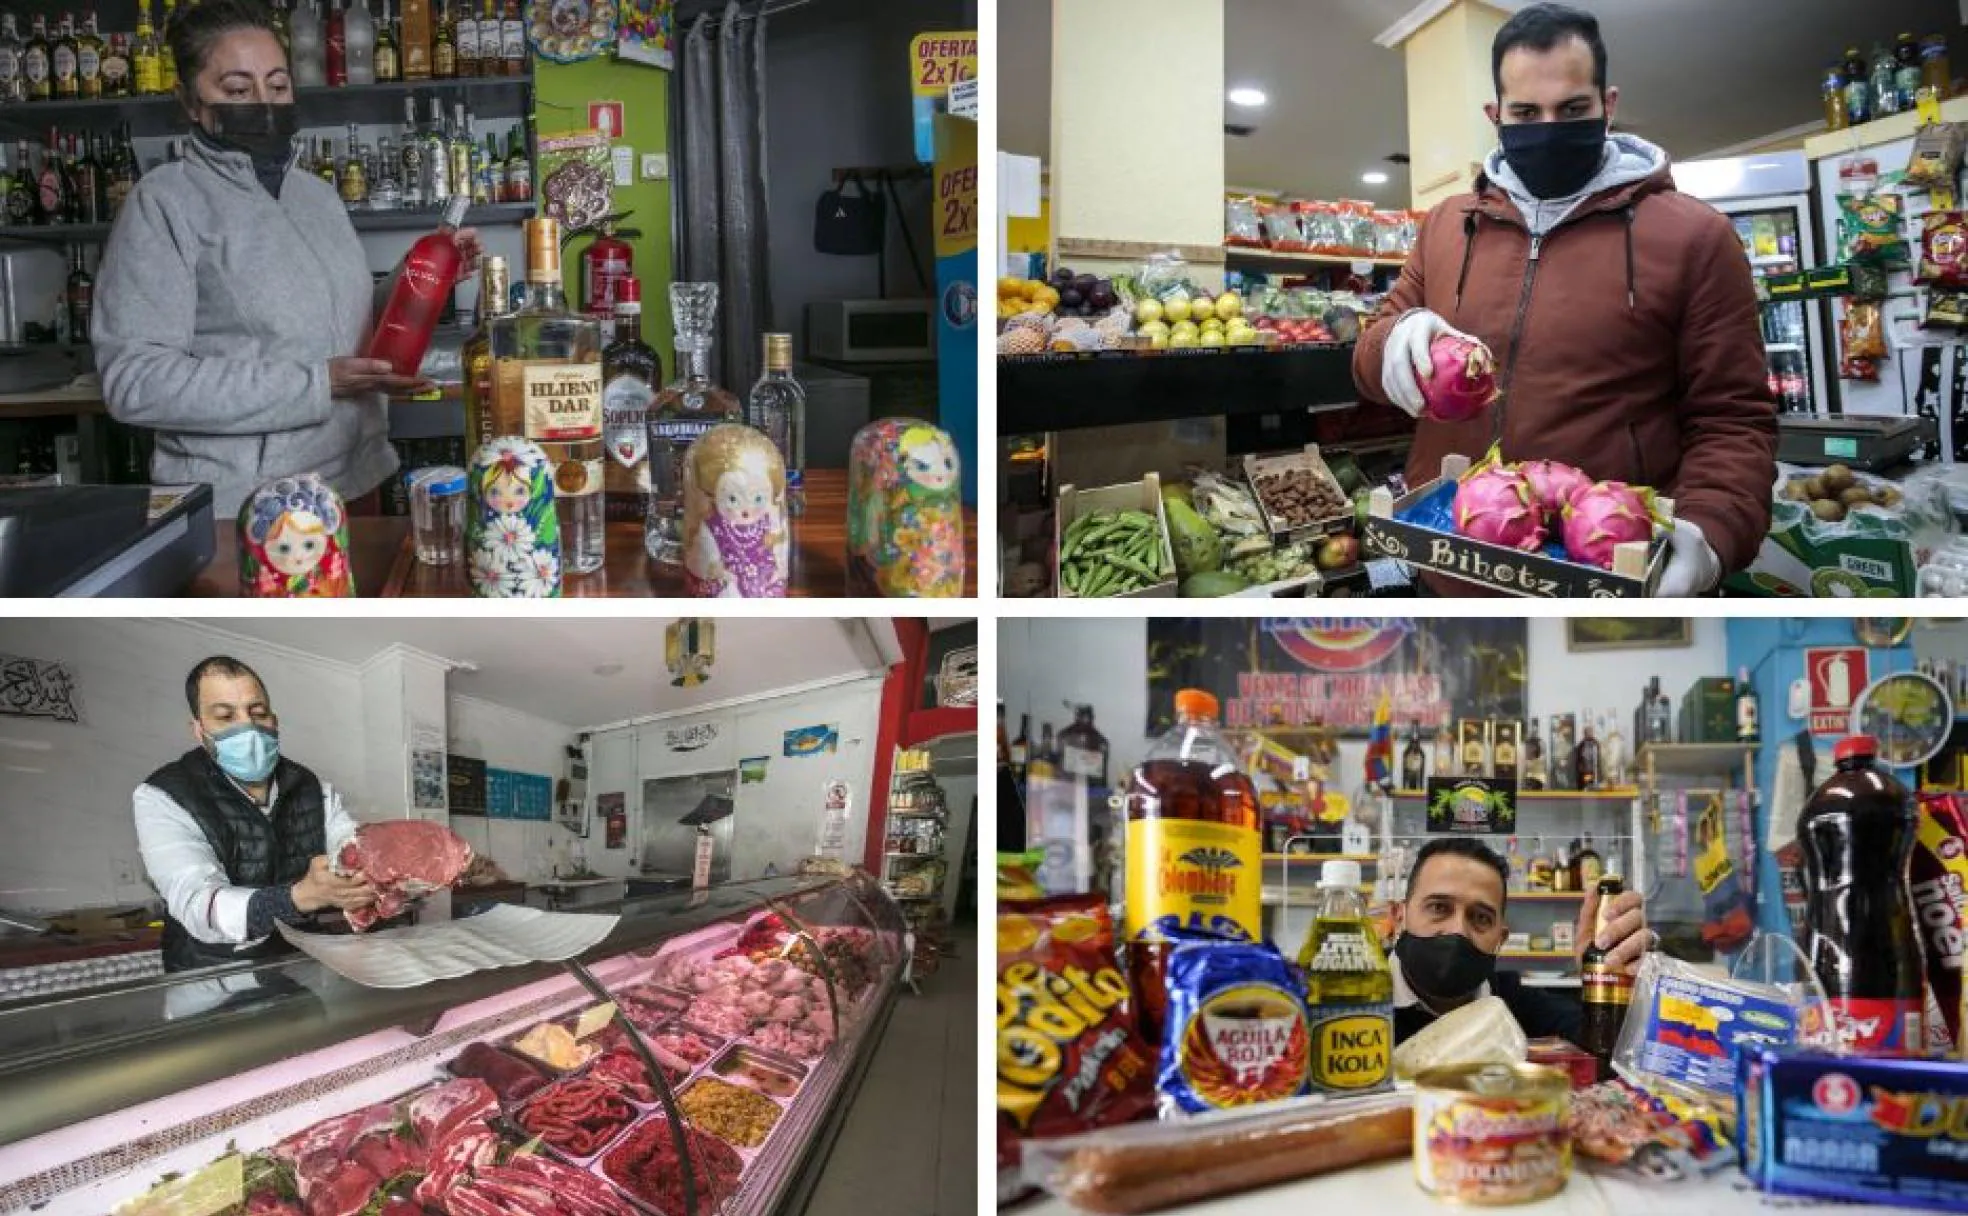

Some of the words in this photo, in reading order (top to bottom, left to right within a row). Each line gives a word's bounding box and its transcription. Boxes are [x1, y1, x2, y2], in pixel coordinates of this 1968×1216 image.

[549, 397, 590, 413] DAR
[1847, 557, 1885, 577] GREEN
[1331, 1029, 1382, 1050] INCA
[1326, 1052, 1384, 1075] KOLA
